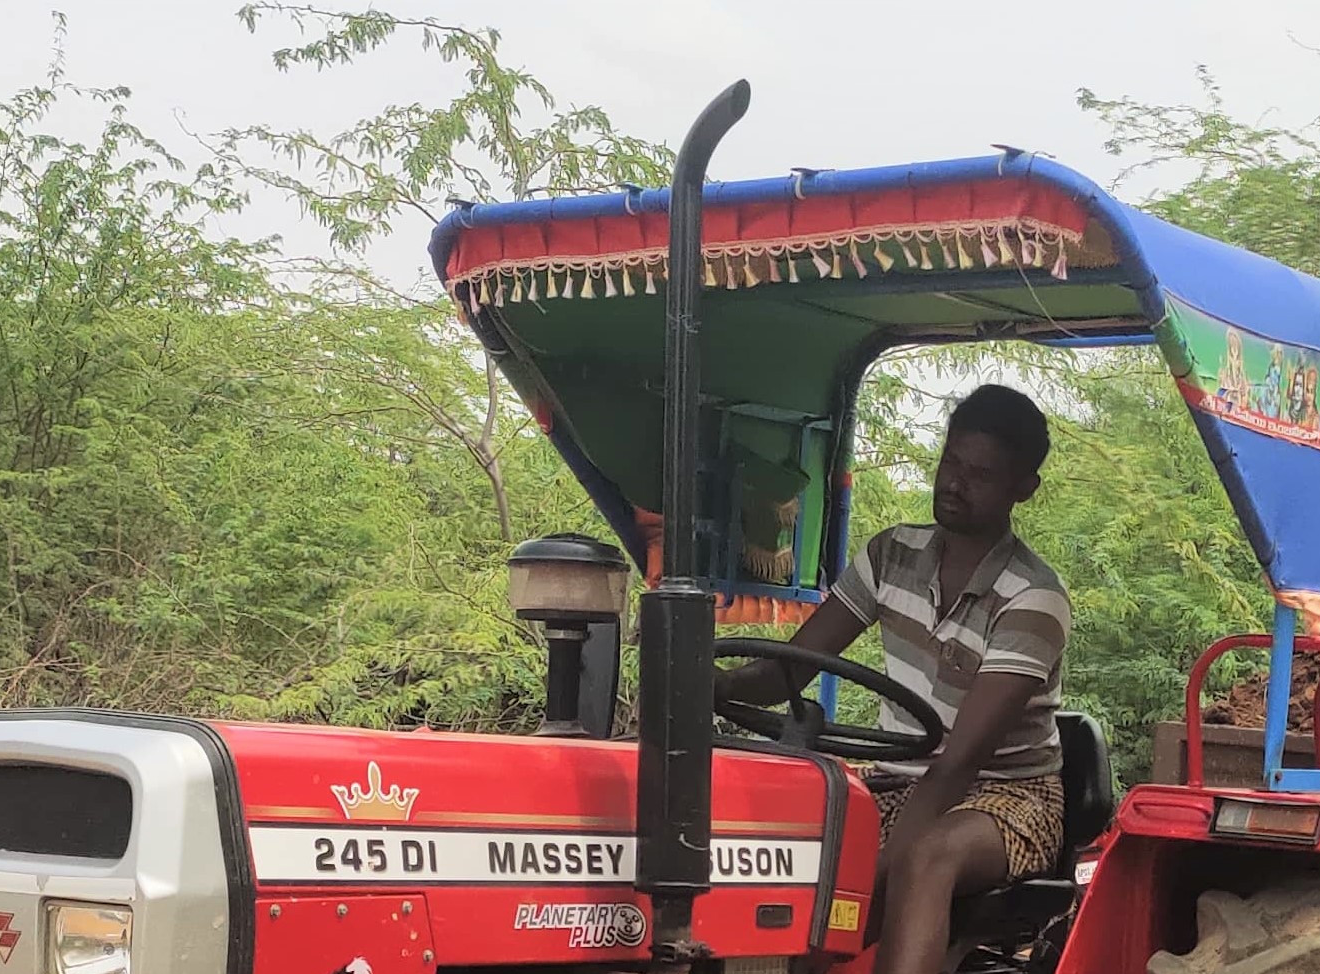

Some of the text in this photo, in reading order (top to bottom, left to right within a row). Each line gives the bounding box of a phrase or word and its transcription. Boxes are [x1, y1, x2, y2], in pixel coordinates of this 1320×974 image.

[314, 837, 794, 877] 245 DI MASSEY USON
[515, 904, 619, 929] PLANETARY
[569, 925, 618, 947] PLUS
